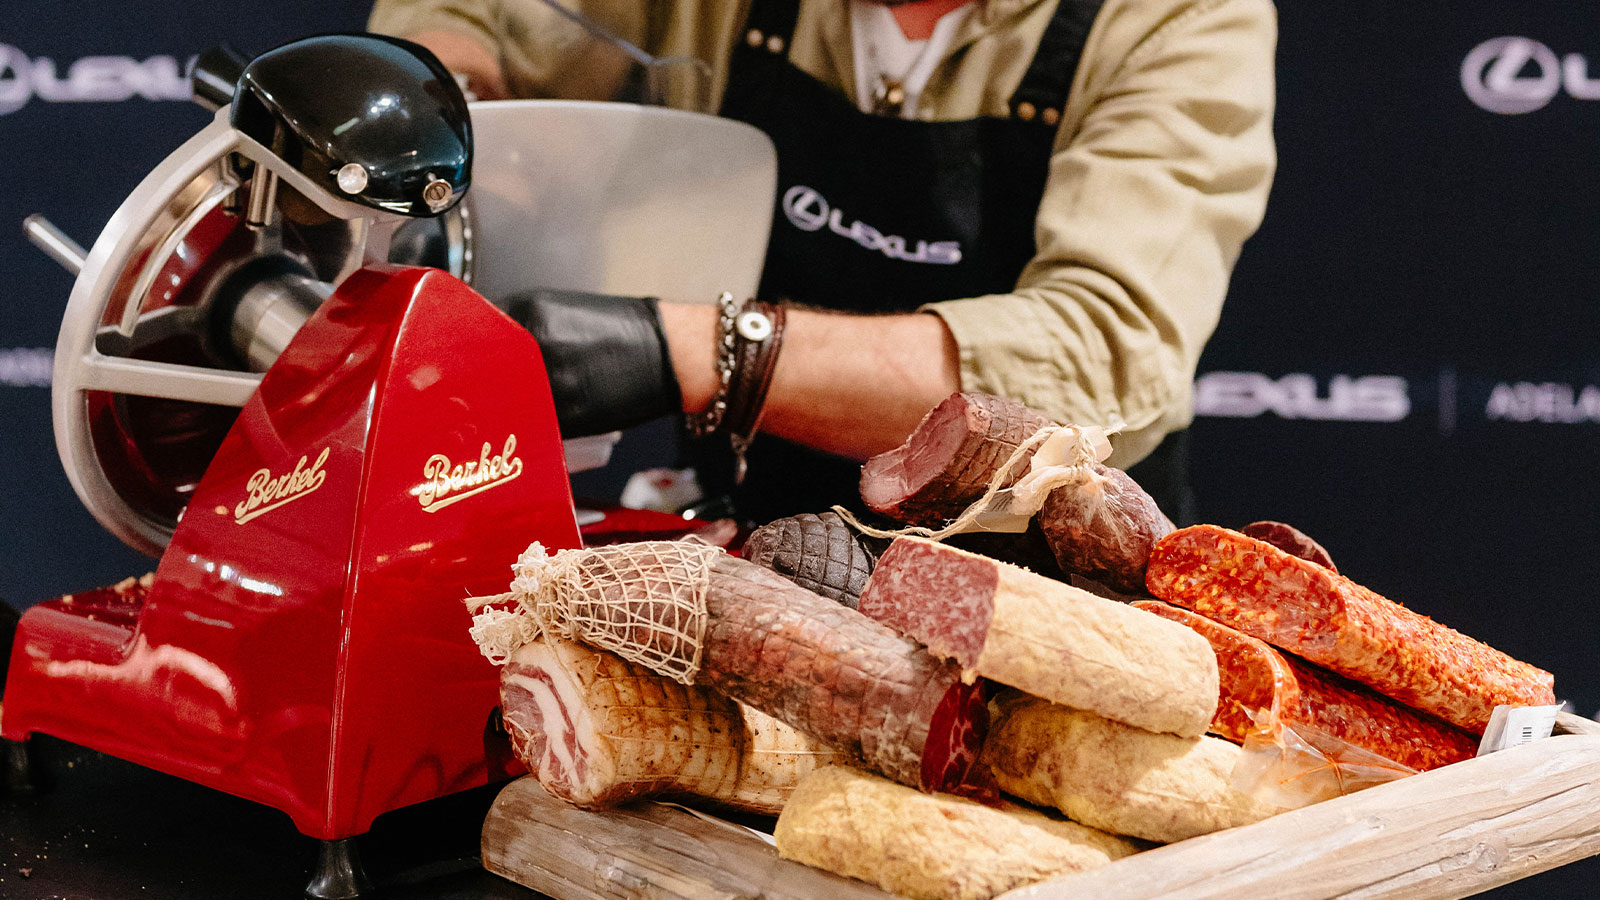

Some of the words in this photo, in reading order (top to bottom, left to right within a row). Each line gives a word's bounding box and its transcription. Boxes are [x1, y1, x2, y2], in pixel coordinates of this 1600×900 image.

[31, 55, 199, 102] LEXU
[828, 208, 963, 265] LEXUS
[1193, 371, 1410, 422] EXUS
[234, 446, 330, 525] Berkel
[410, 433, 523, 513] Berkel
